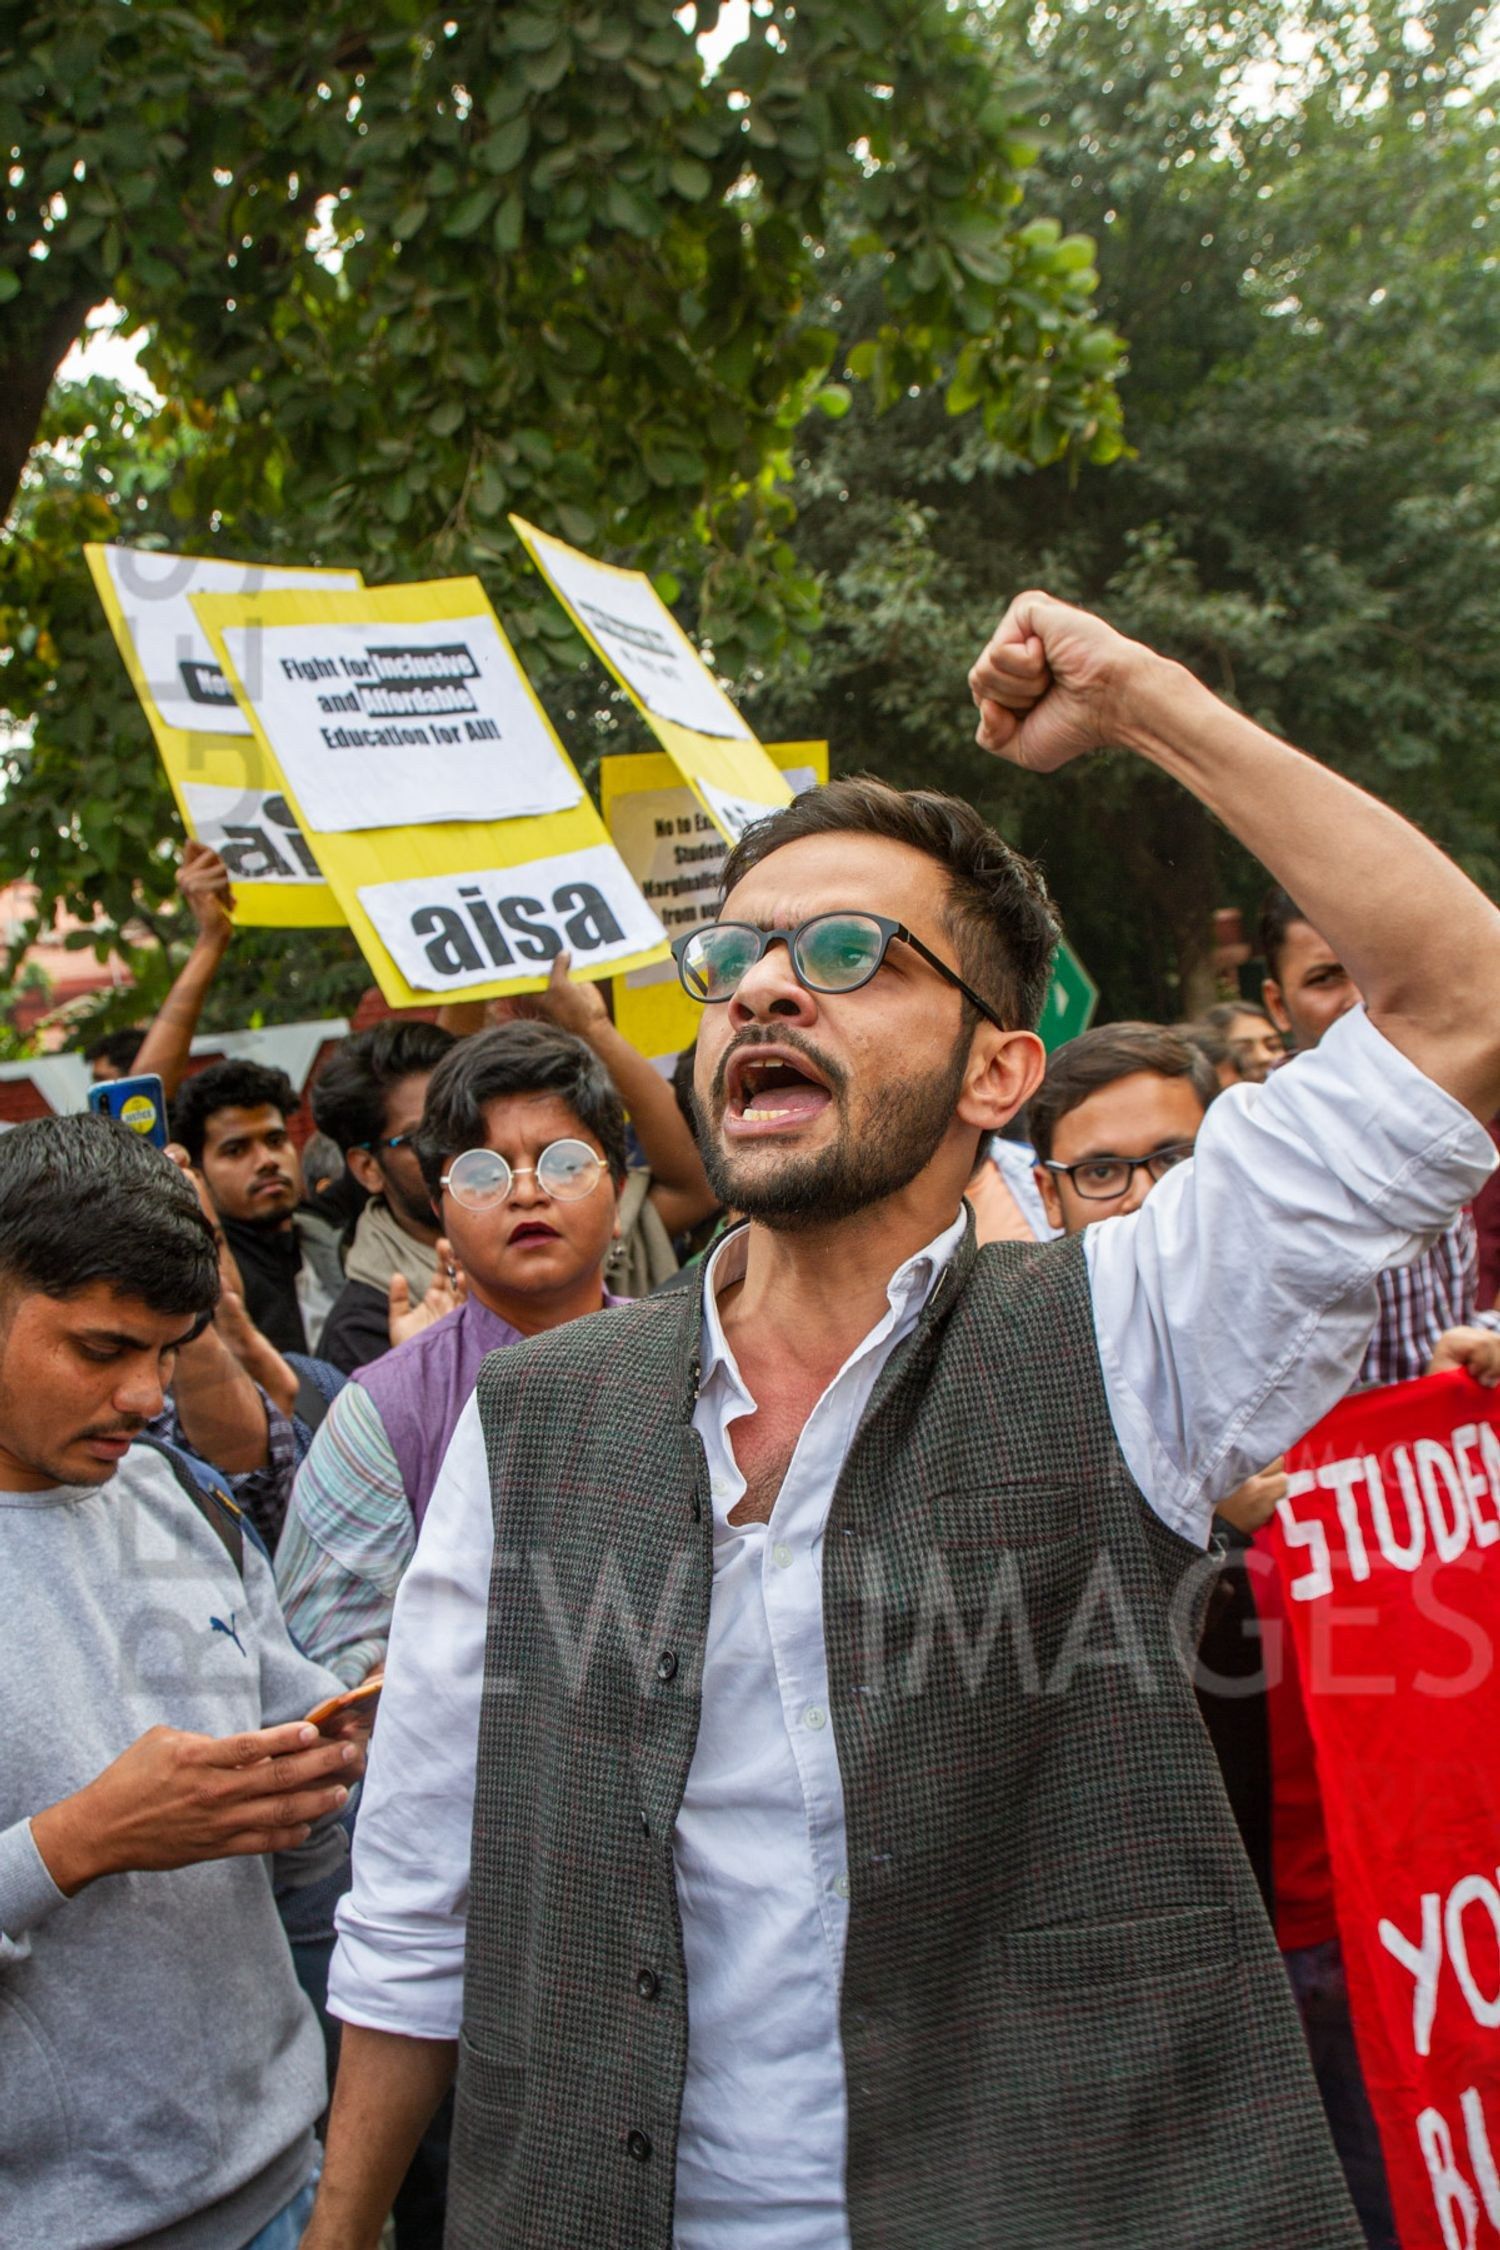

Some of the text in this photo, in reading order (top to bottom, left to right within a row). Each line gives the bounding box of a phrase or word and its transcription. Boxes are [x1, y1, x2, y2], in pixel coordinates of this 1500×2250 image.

[279, 651, 475, 681] Fight for Inclusive
[316, 684, 474, 715] and Affordable
[319, 725, 430, 750] Education
[428, 722, 461, 745] for
[219, 793, 323, 878] ai
[410, 880, 627, 976] aisa
[1377, 1865, 1500, 2057] YO
